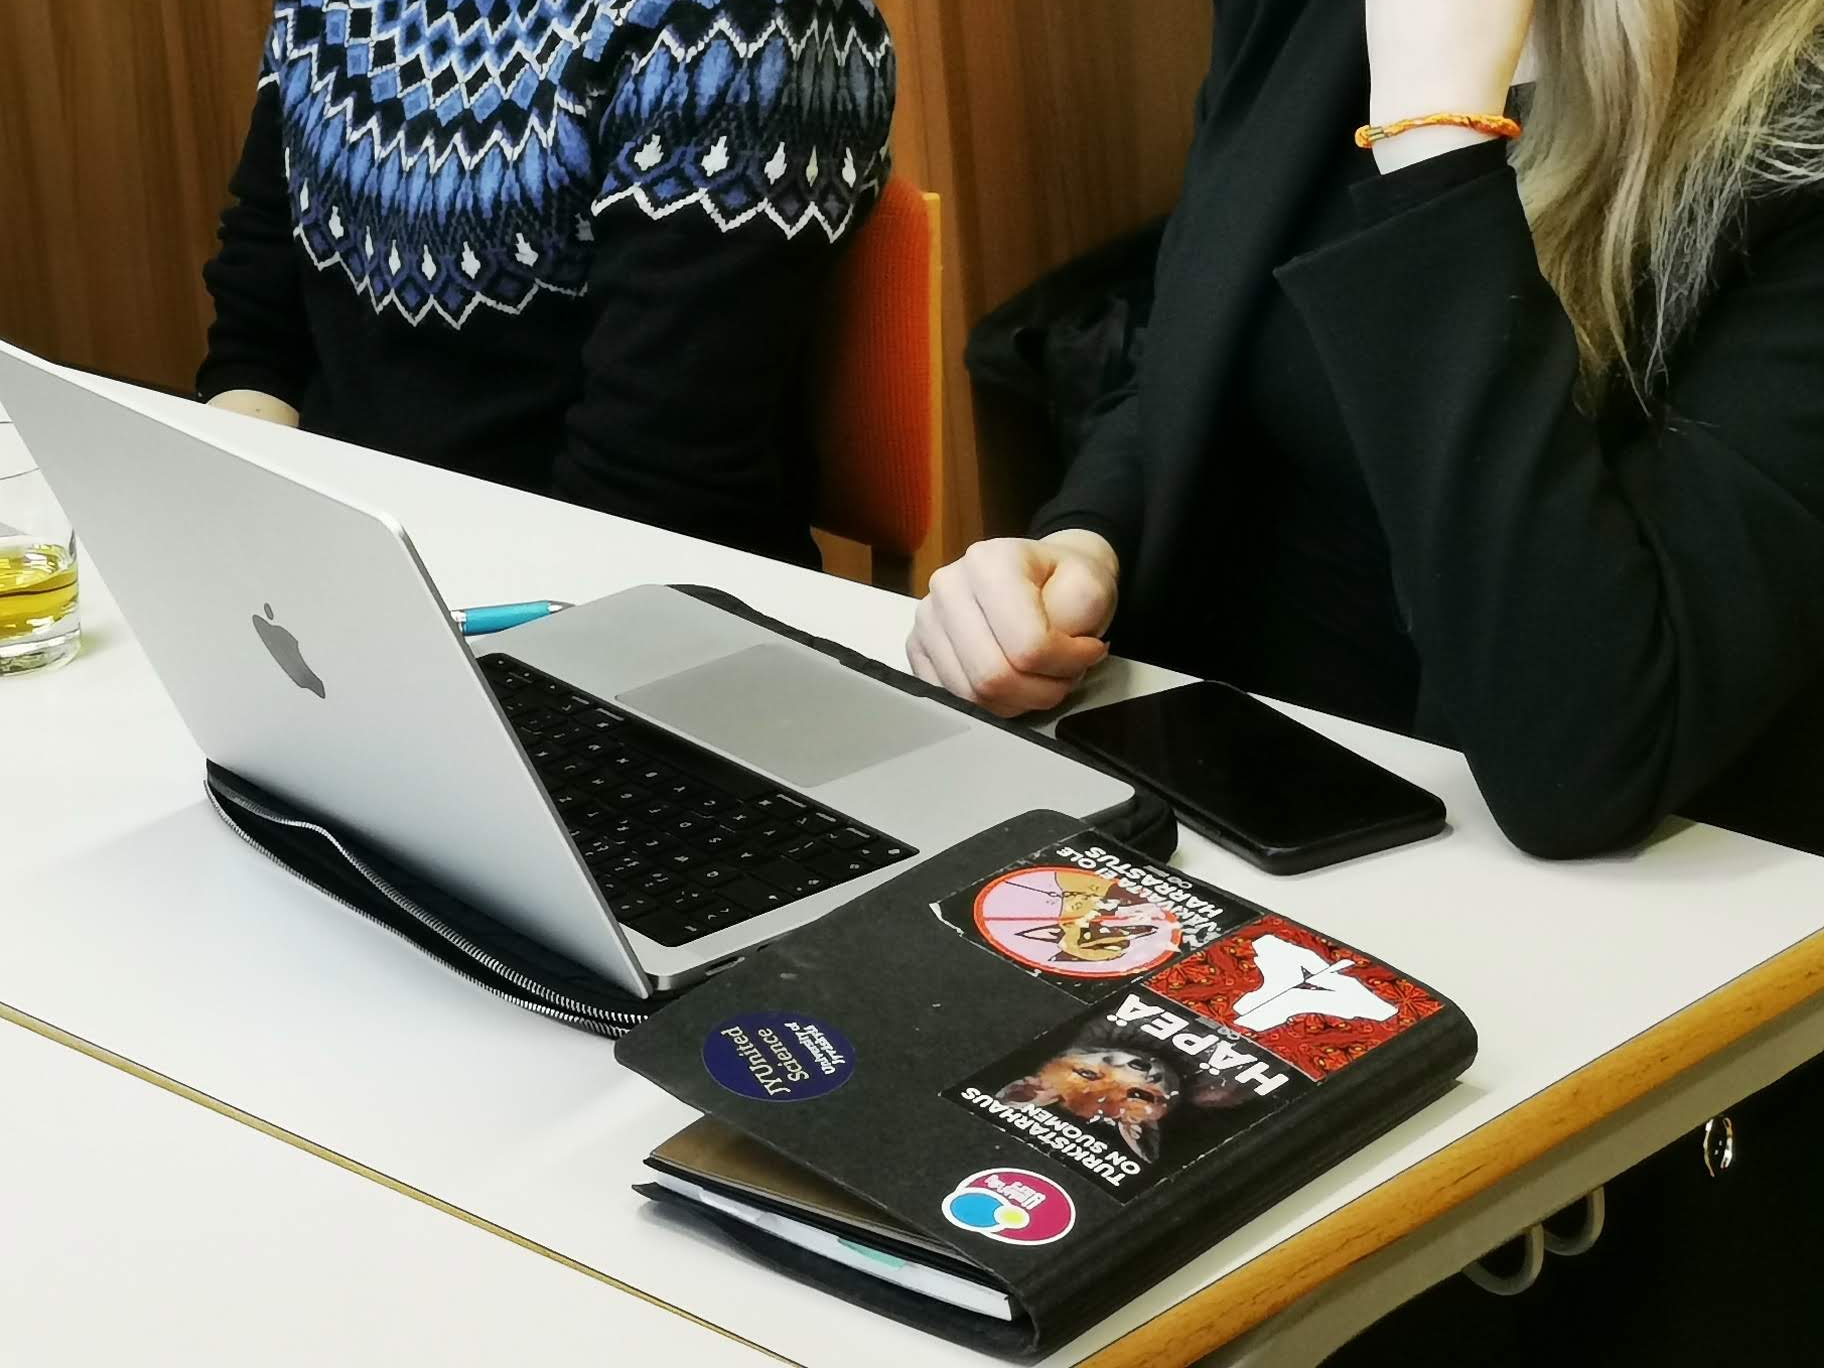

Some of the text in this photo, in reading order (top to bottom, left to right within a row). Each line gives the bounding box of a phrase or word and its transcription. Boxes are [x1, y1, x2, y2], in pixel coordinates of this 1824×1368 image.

[1056, 846, 1096, 869] OLE
[1084, 846, 1224, 919] HARRASTUS
[721, 1026, 791, 1096] JYUnited
[758, 1028, 809, 1081] Science
[1106, 994, 1289, 1096] HÄPEÄ
[961, 1087, 1125, 1187] TURKISTARHAUS
[1021, 1103, 1141, 1175] ON SUOMEN
